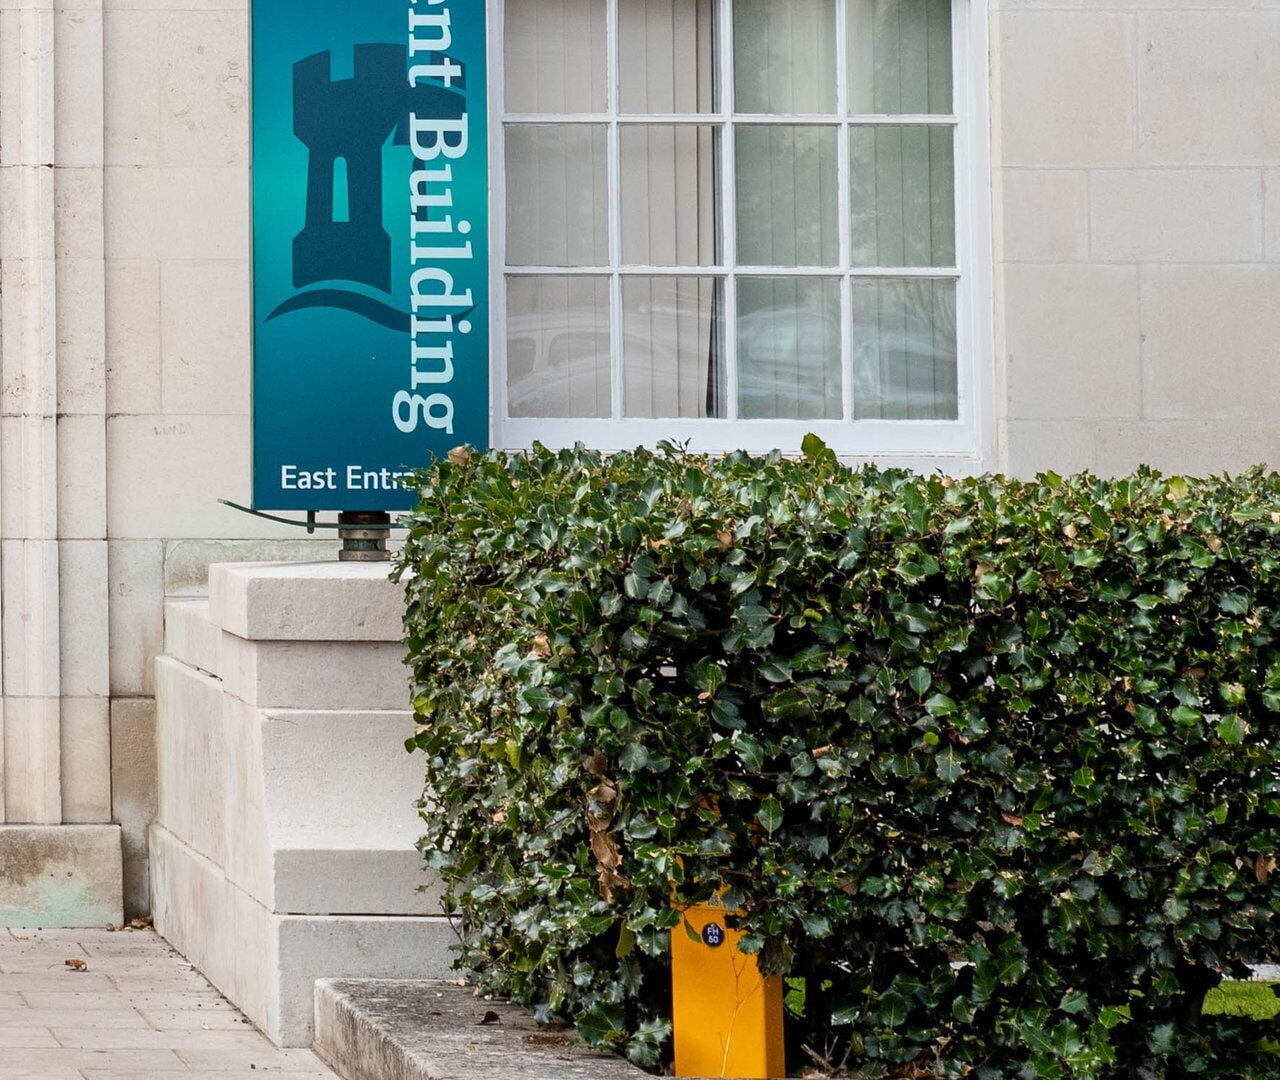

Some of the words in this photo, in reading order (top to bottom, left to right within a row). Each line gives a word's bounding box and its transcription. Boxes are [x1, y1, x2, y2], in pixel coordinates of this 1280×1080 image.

[392, 112, 473, 435] Building
[281, 465, 337, 490] East
[707, 927, 719, 935] FH
[708, 935, 719, 943] 50
